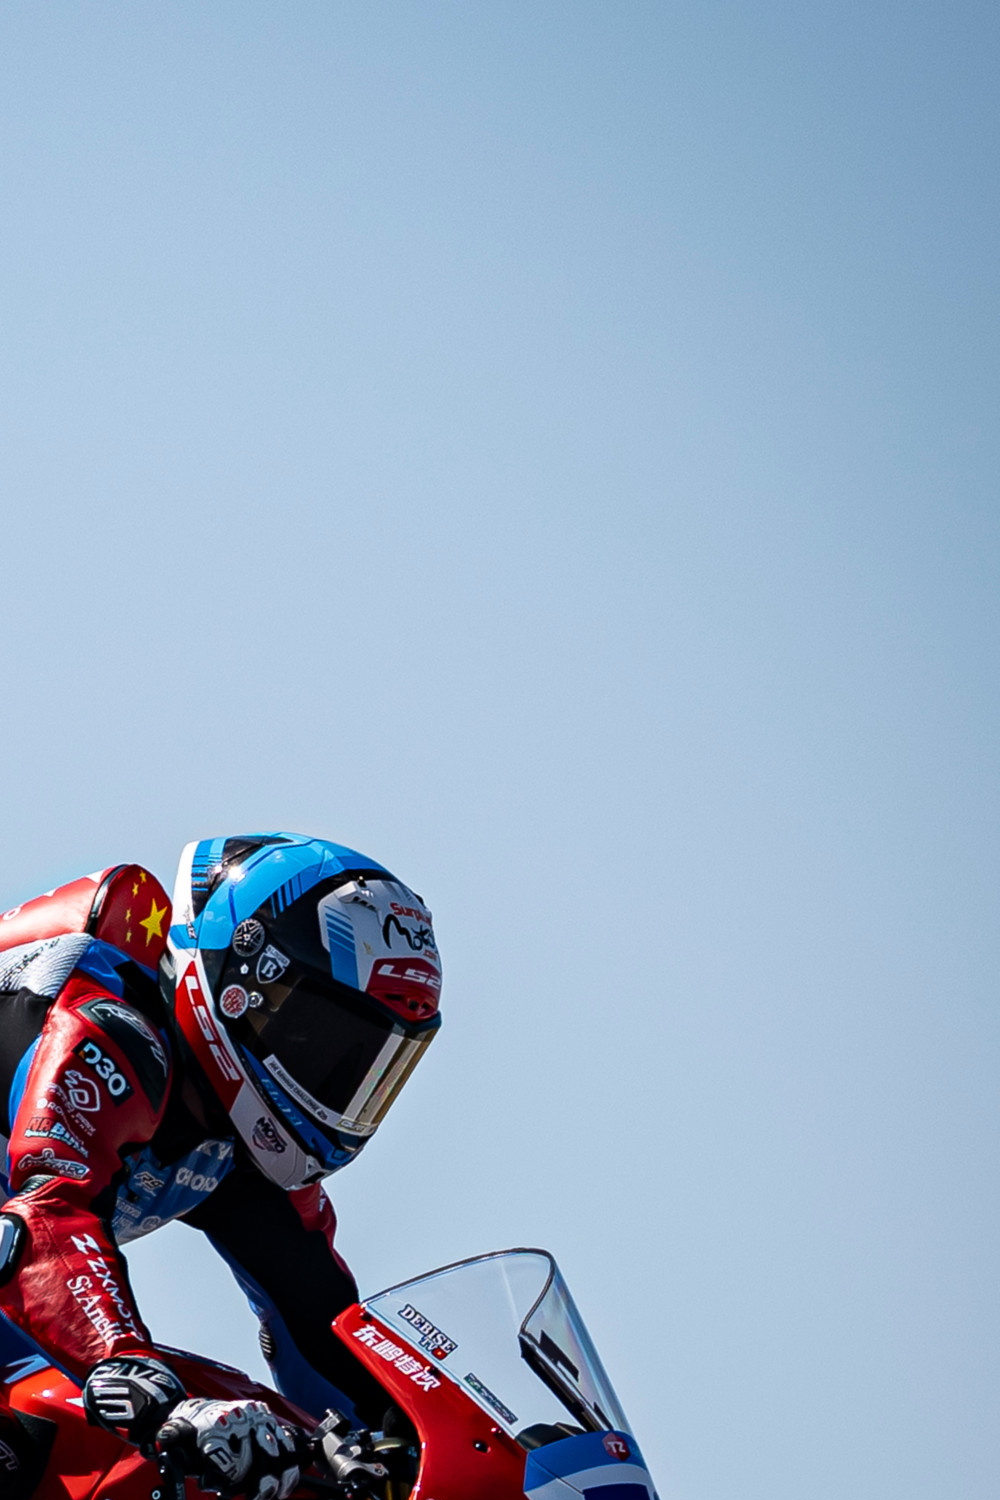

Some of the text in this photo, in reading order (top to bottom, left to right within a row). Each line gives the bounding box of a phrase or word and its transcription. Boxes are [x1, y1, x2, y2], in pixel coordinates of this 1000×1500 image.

[185, 975, 240, 1081] LS2
[256, 1116, 287, 1153] MOTO
[400, 1305, 456, 1354] DEBISE
